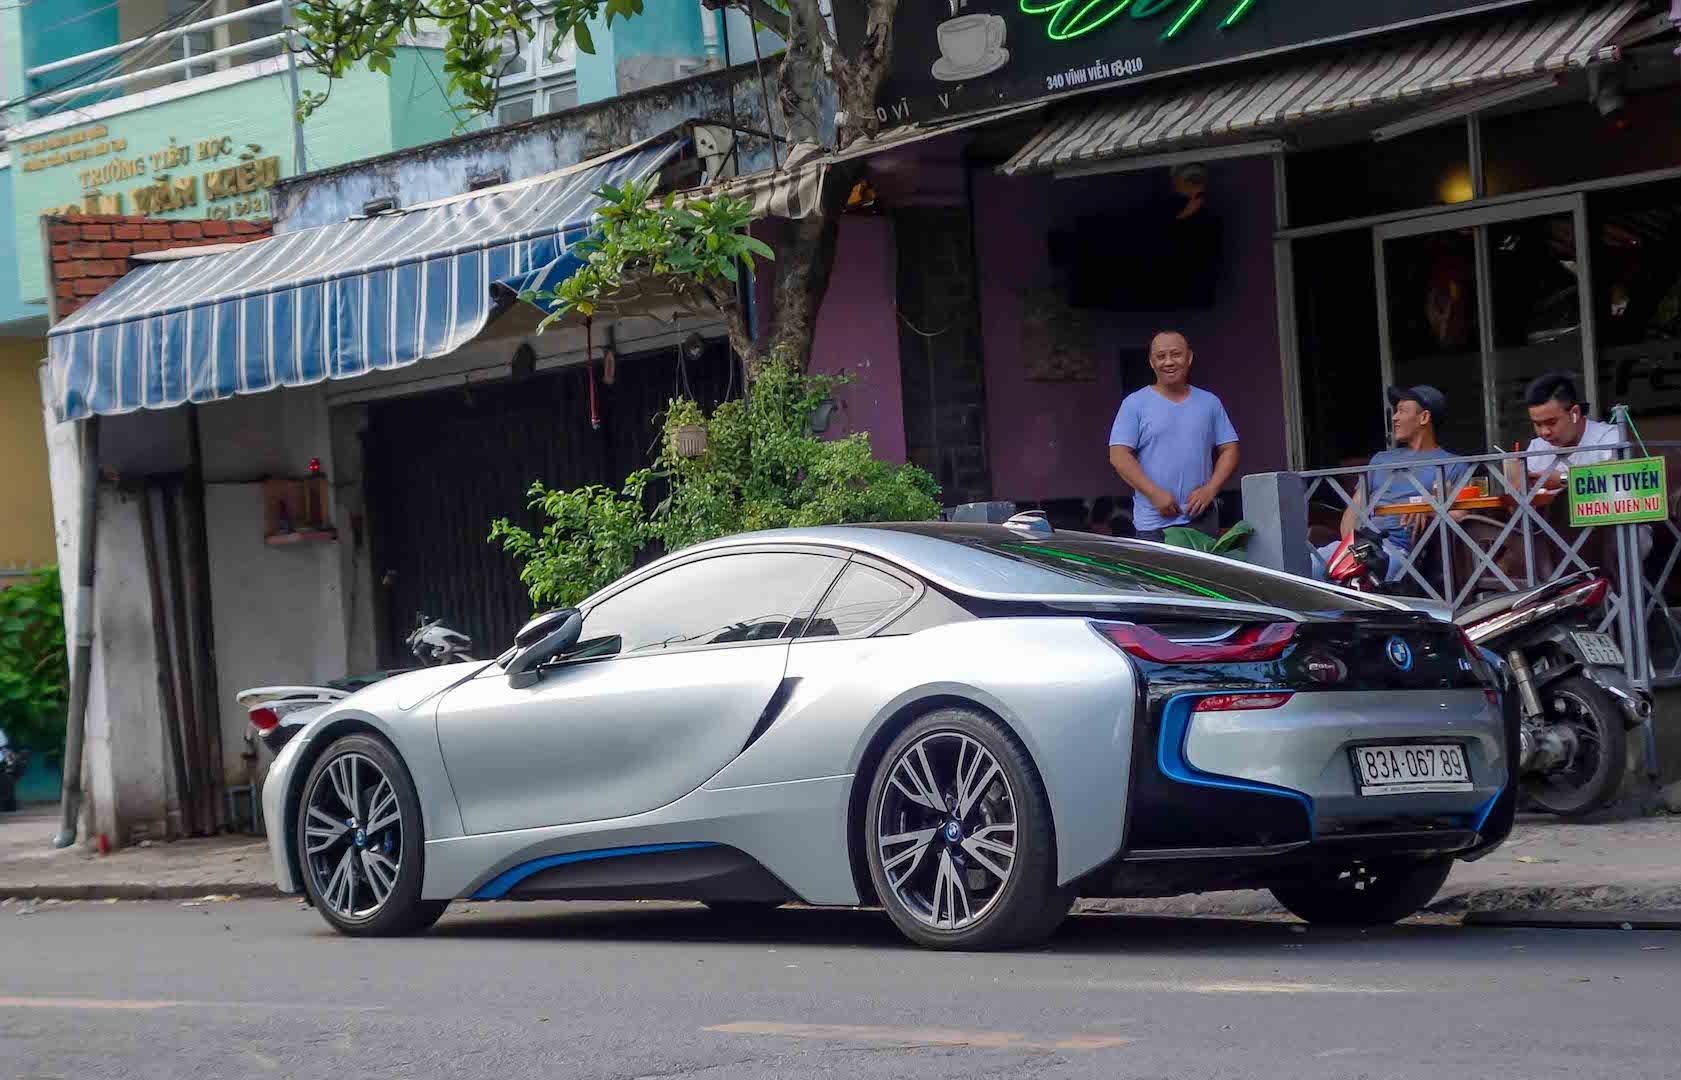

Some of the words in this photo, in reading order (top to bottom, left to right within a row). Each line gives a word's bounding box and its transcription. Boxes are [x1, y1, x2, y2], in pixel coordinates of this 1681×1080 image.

[1046, 75, 1064, 90] 340
[1065, 68, 1087, 86] VĨNH
[1088, 59, 1110, 81] VIỄN
[1575, 468, 1607, 495] CẦN
